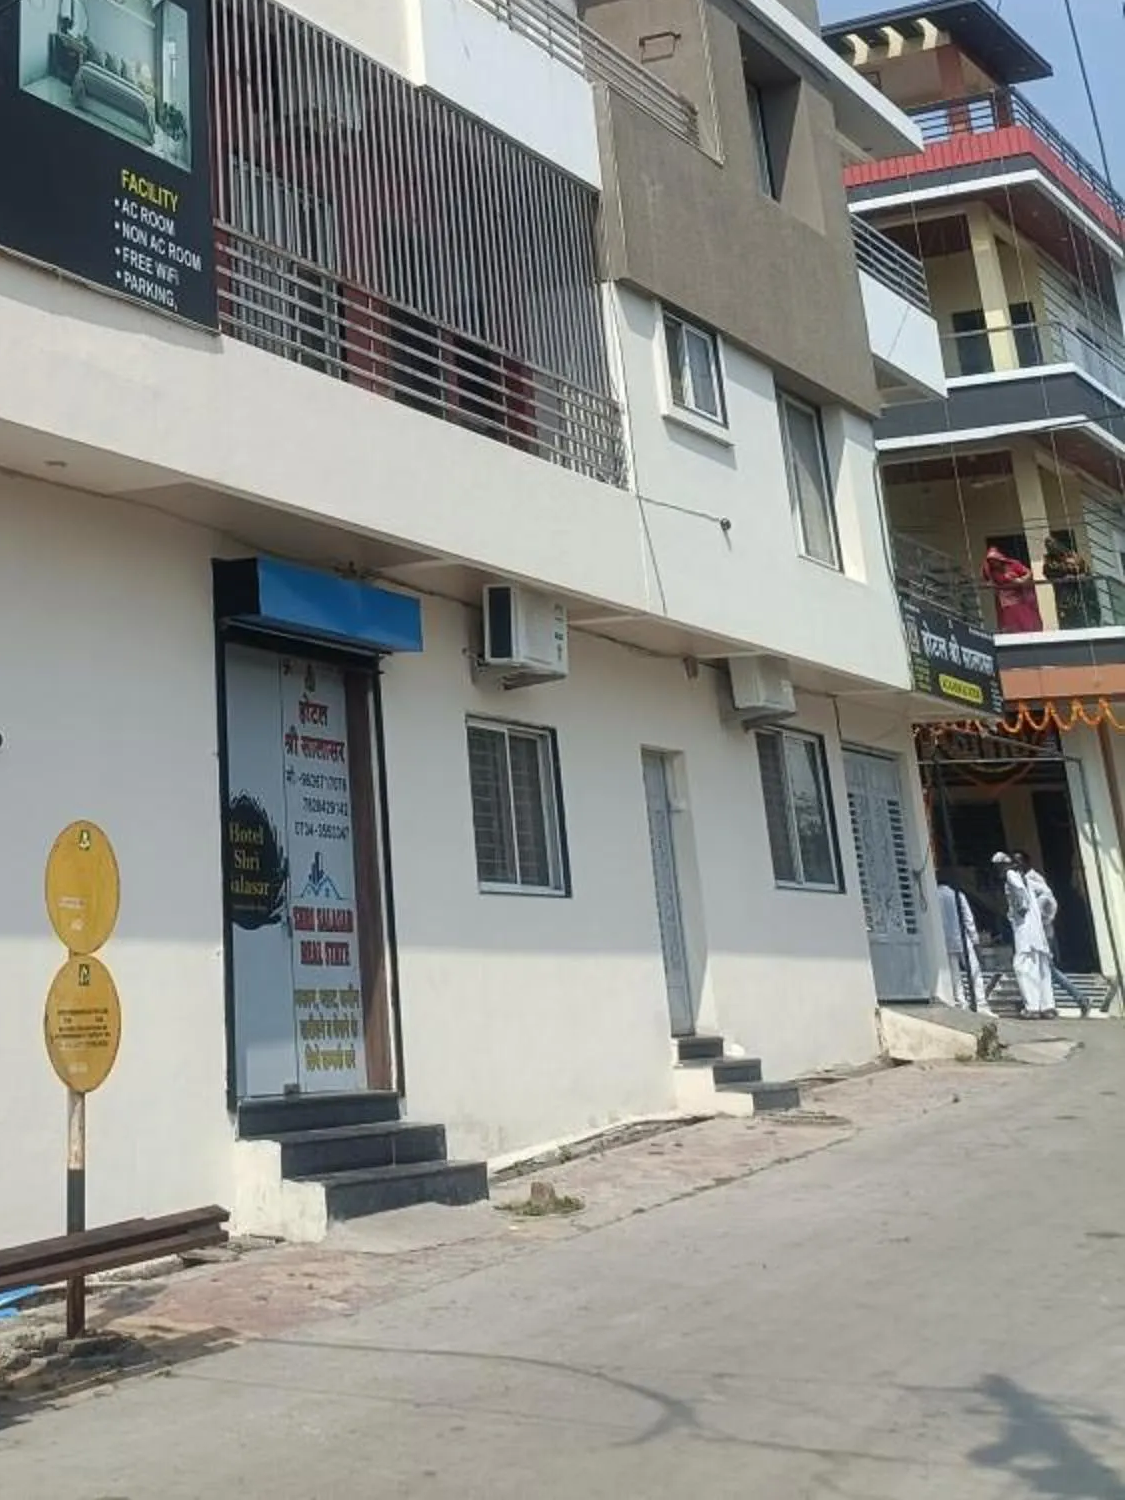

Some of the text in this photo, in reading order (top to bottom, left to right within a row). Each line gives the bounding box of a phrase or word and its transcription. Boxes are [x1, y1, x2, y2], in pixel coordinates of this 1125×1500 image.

[121, 168, 178, 212] FACILITY
[121, 198, 175, 236] AC ROOM
[122, 221, 203, 272] NON AC ROOM
[122, 247, 154, 275] FREE
[230, 873, 270, 896] alasar
